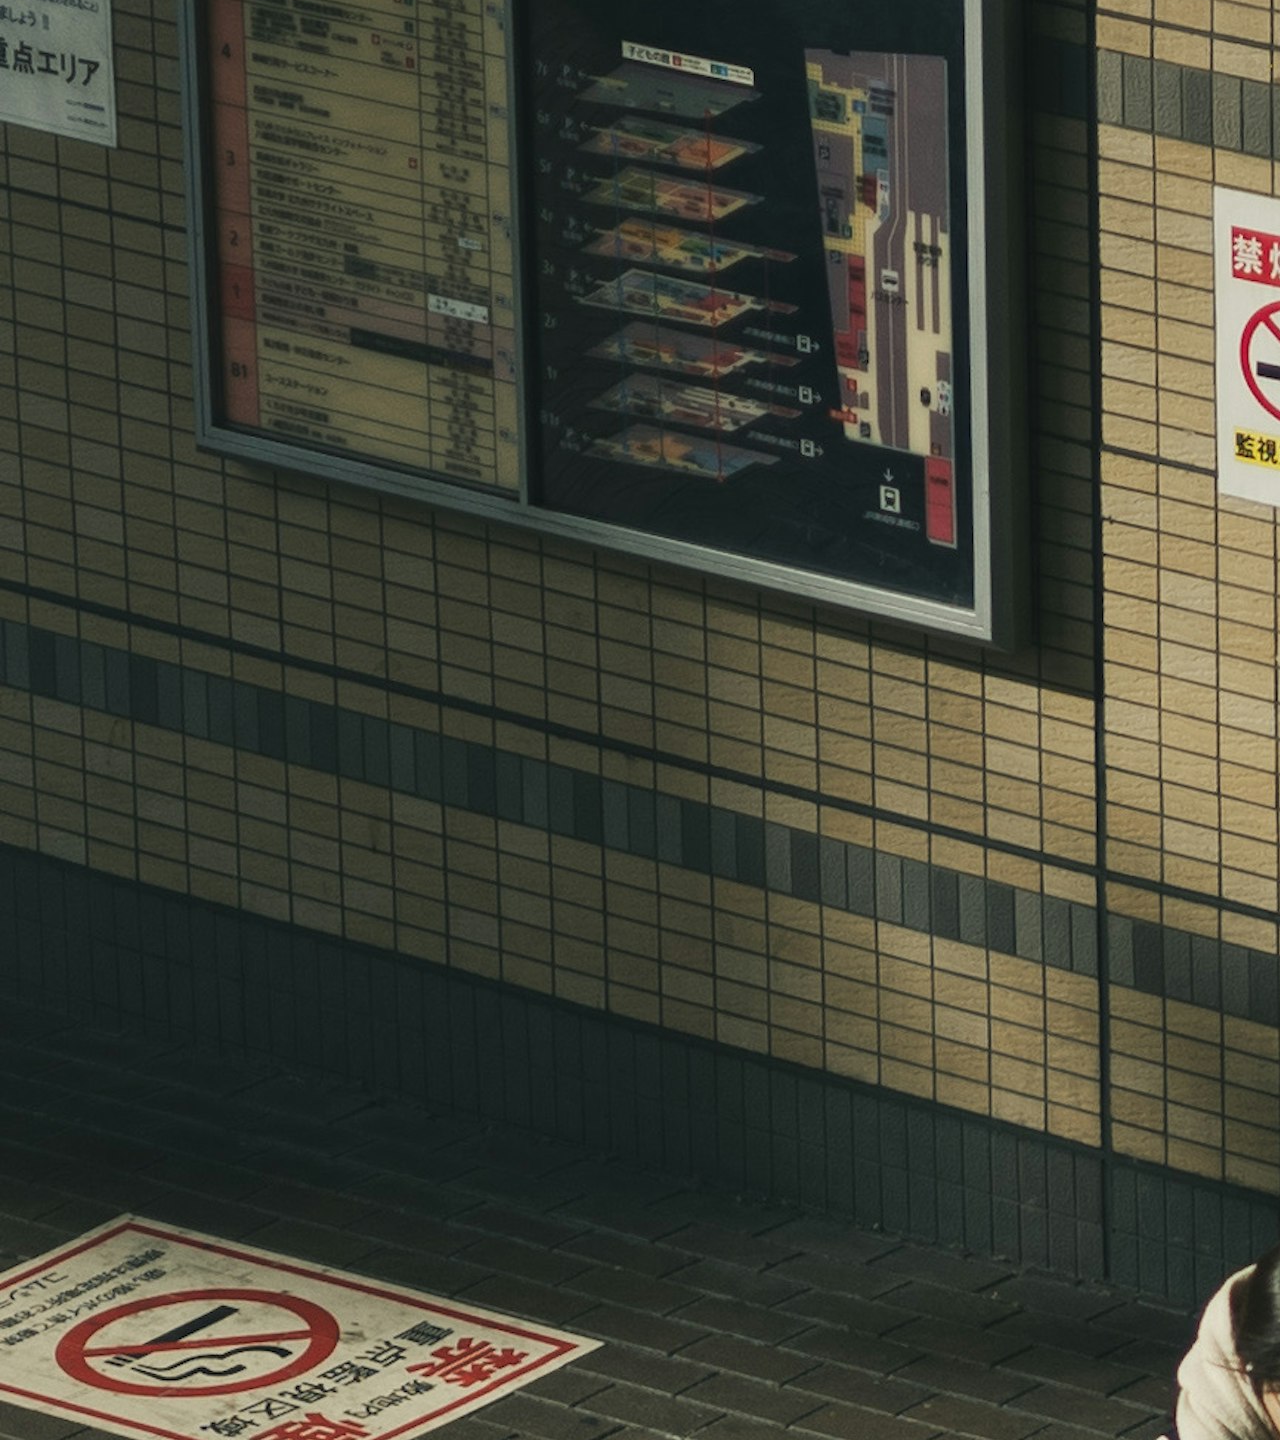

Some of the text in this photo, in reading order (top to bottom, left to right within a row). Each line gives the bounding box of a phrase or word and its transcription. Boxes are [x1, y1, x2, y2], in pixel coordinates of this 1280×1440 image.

[193, 1320, 465, 1440] 重点監視区域
